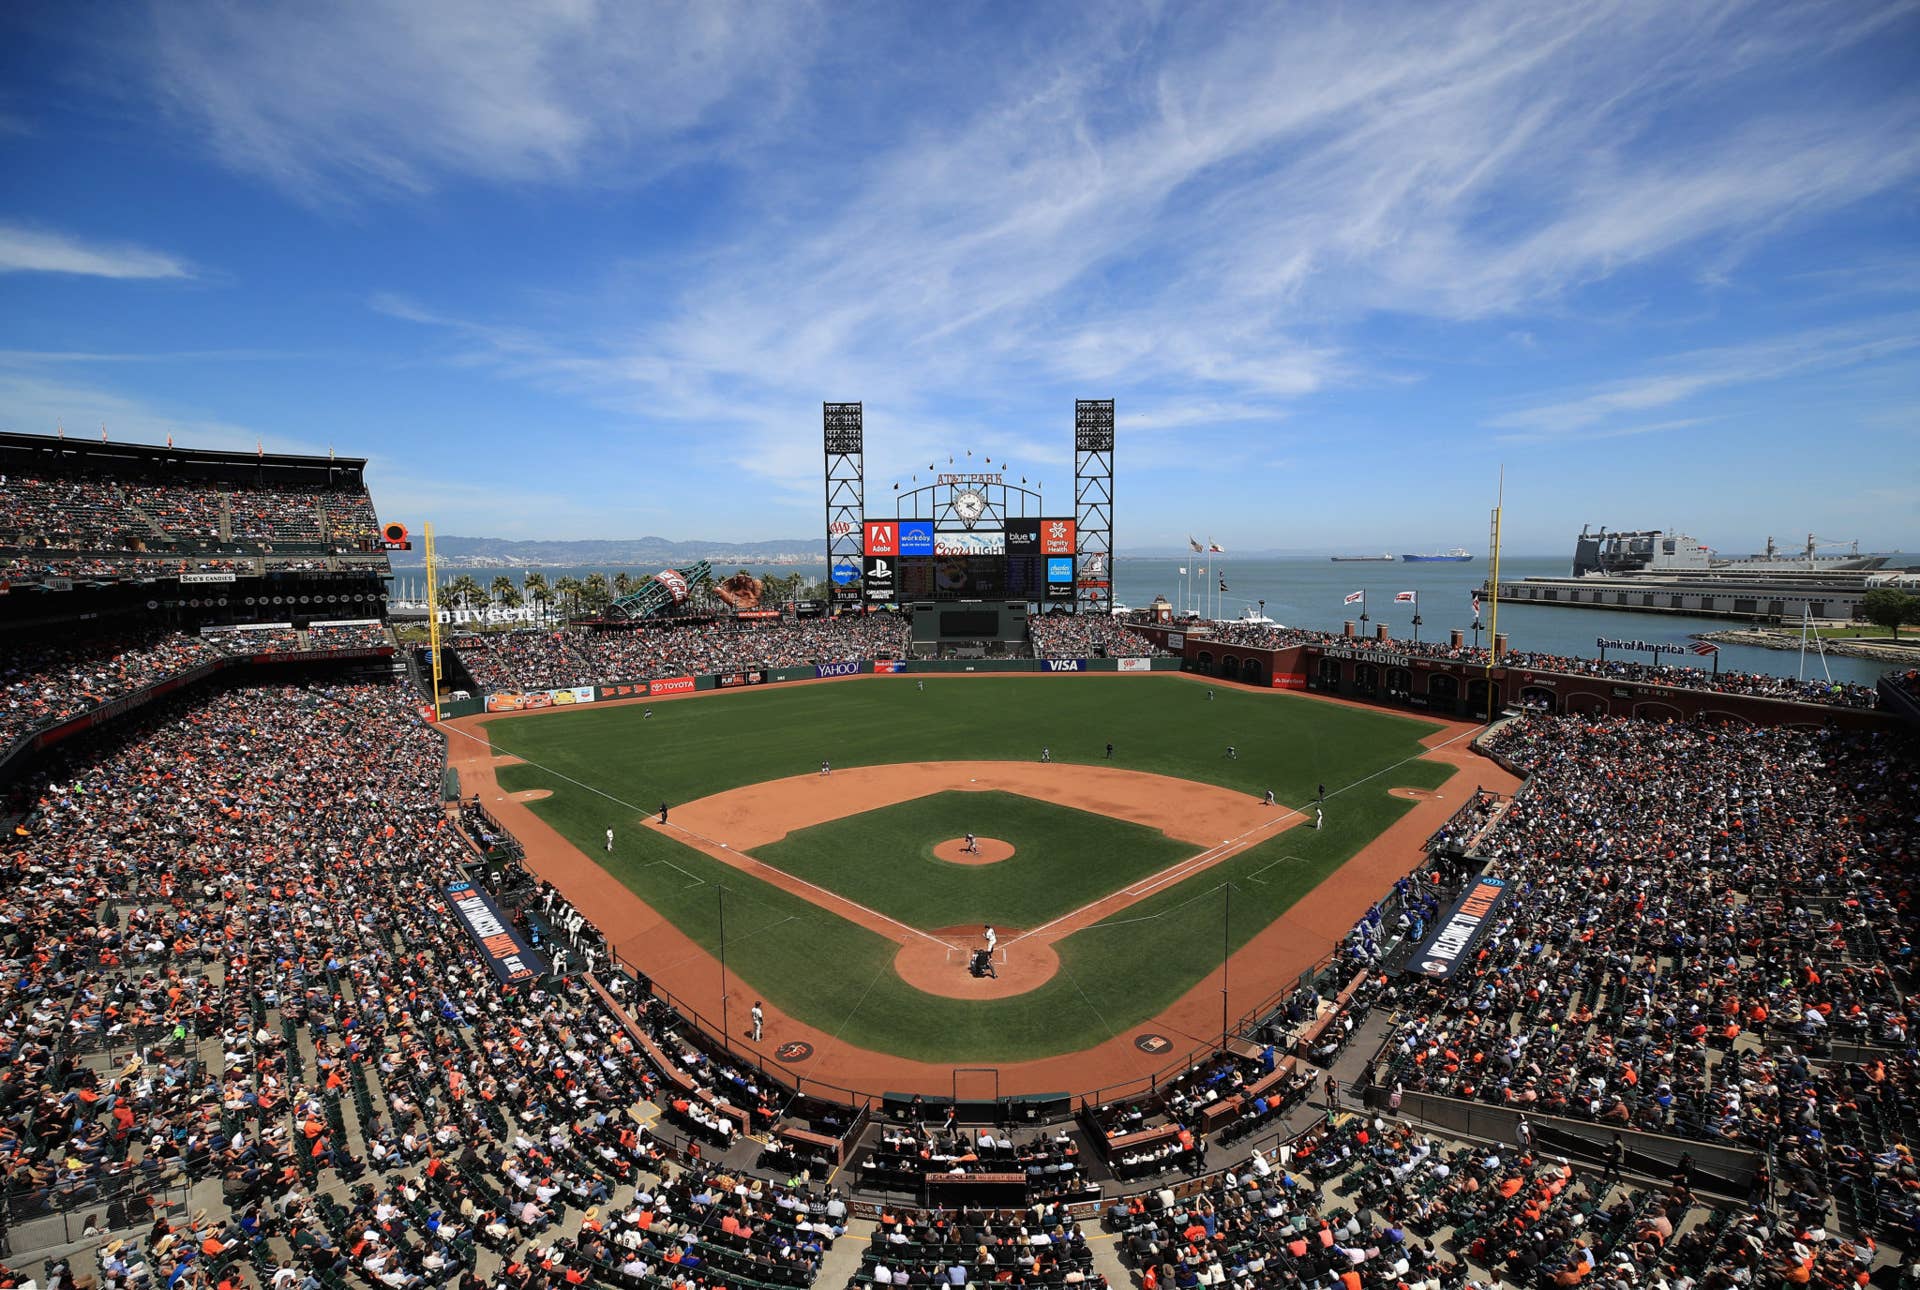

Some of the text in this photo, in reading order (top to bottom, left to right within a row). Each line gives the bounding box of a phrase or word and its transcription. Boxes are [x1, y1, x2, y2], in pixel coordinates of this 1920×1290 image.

[937, 474, 1003, 485] AT&T PARK
[830, 522, 850, 533] AAA
[1009, 532, 1028, 540] blue
[934, 542, 971, 556] Coors
[972, 546, 1005, 555] LIGHT
[1597, 638, 1685, 654] Bank of America
[270, 649, 379, 662] FLY VIRGIN AMERICA
[1355, 653, 1409, 667] LANDING
[818, 662, 859, 677] YAHOO!
[1049, 660, 1078, 671] VISA
[663, 681, 694, 690] TOYOTA
[463, 908, 505, 938] FRANCISCO
[482, 933, 520, 959] GIANTS
[1426, 921, 1476, 960] WELCOME
[853, 1203, 873, 1213] blue
